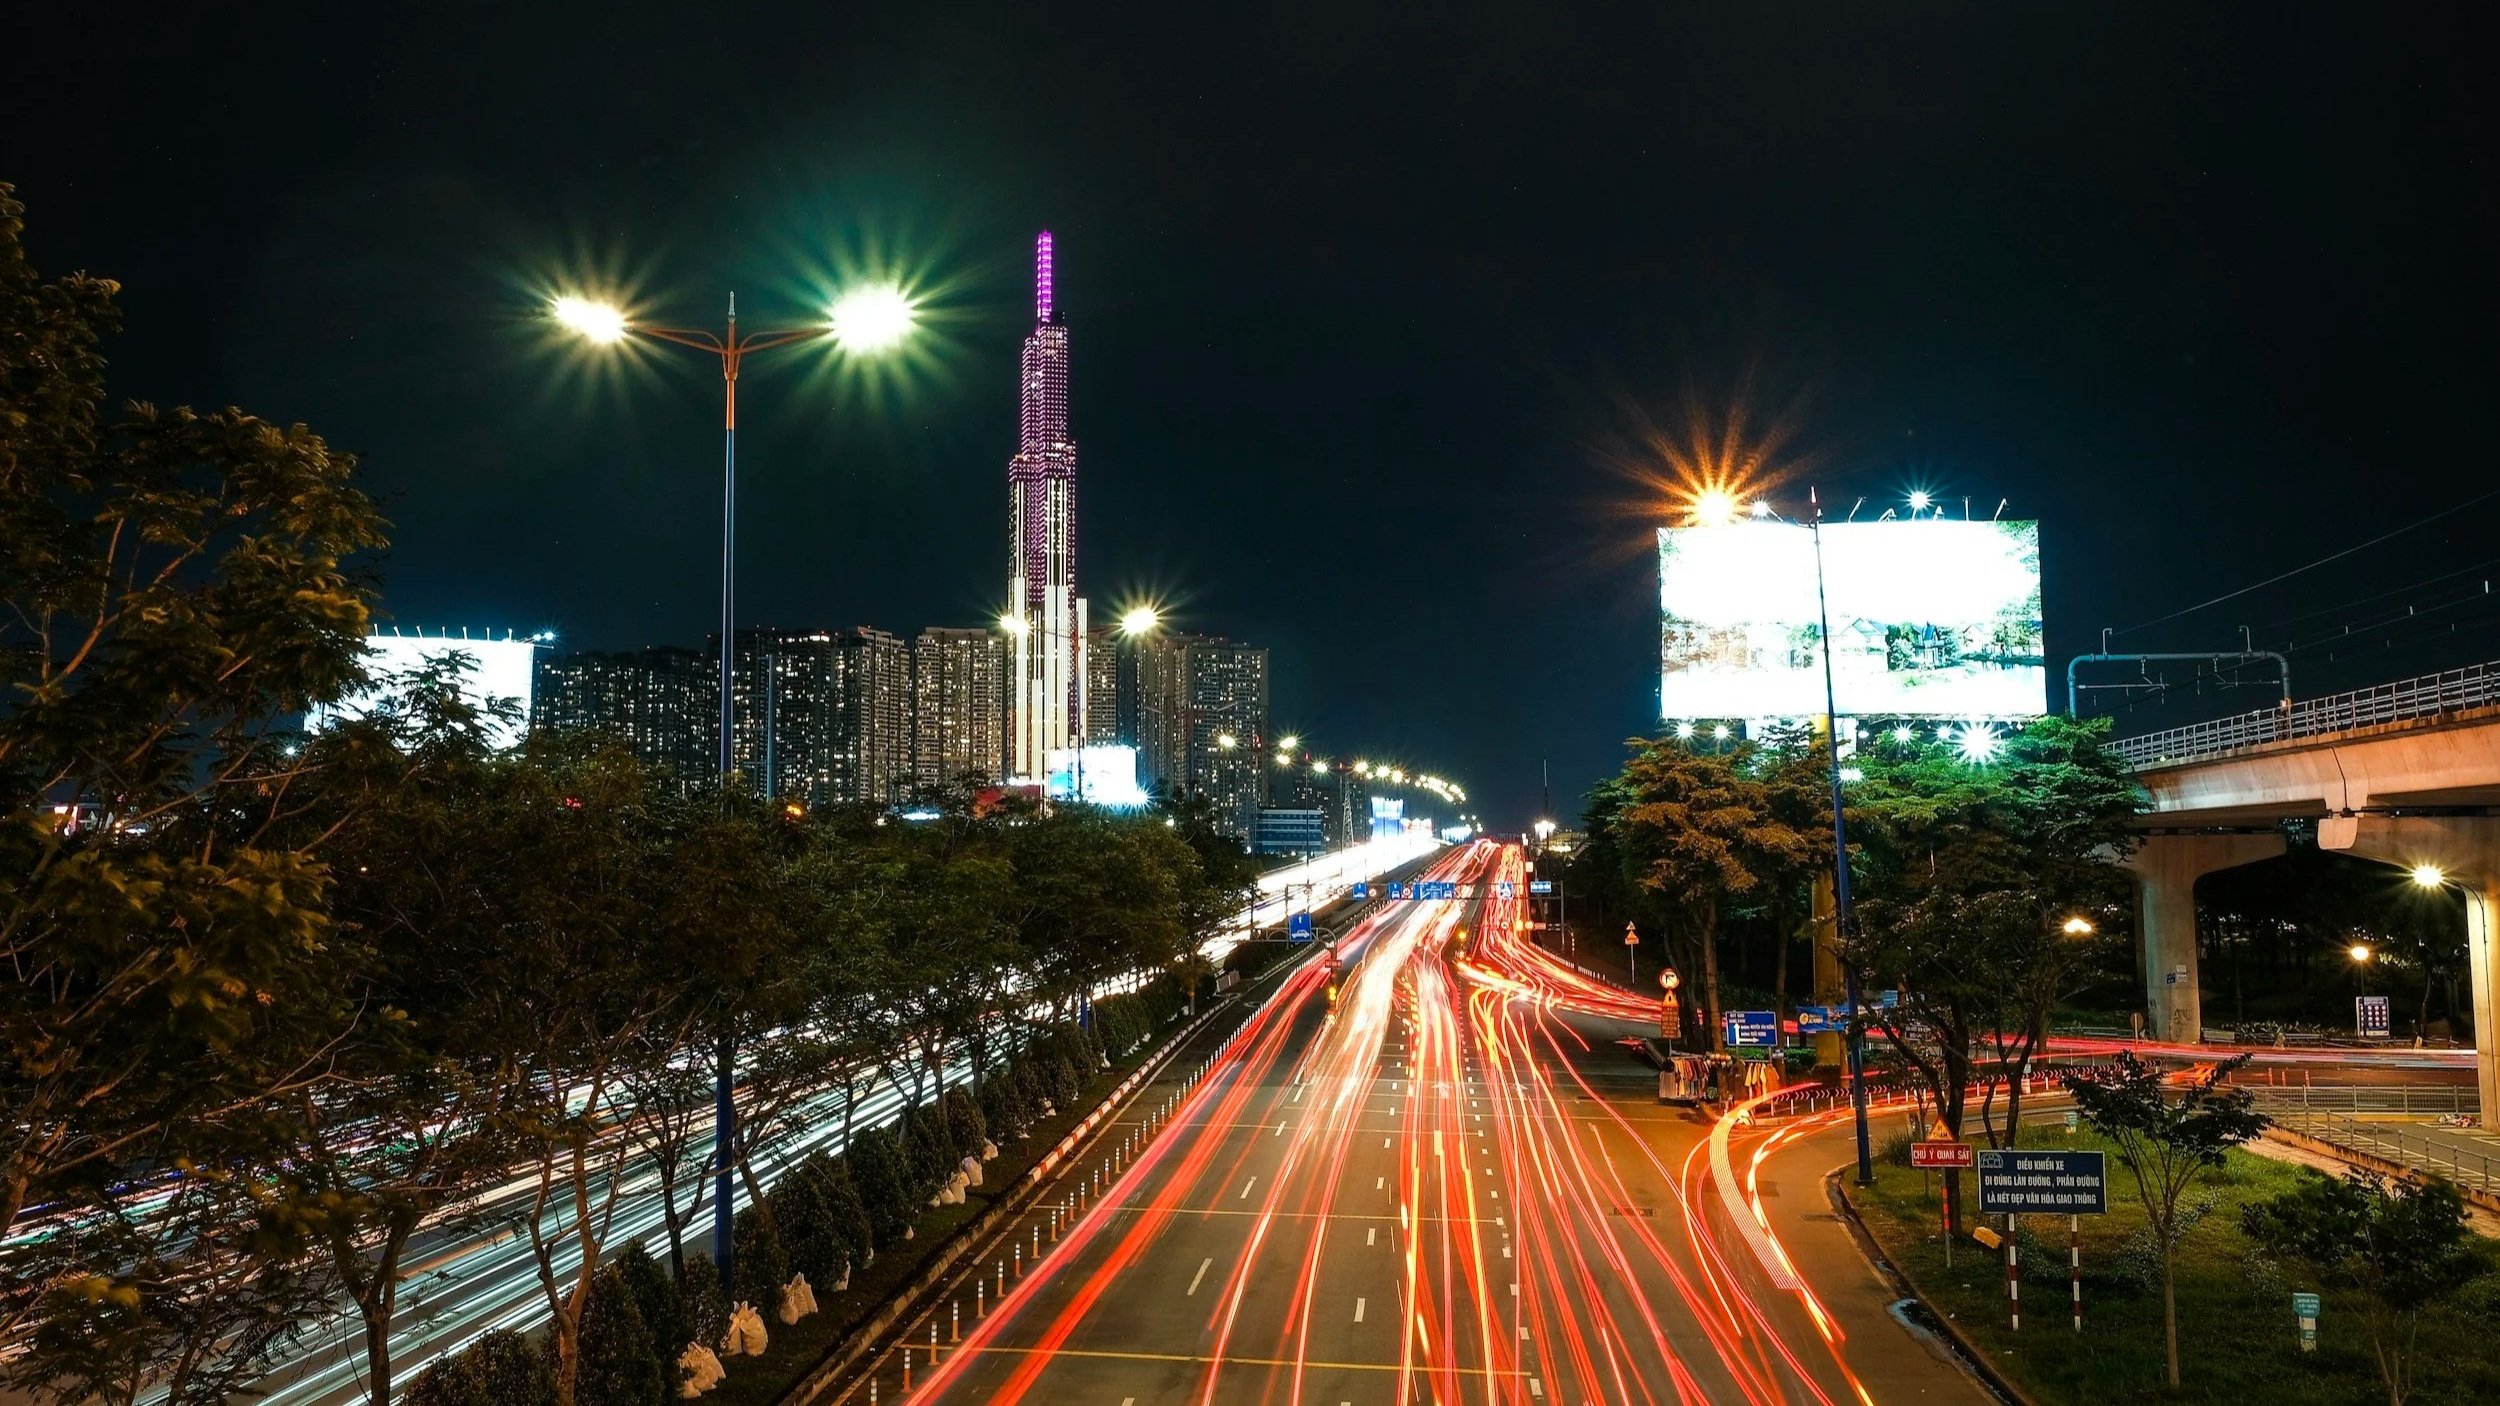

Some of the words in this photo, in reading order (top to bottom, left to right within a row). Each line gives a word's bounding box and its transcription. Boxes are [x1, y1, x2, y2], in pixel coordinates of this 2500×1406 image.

[1913, 1147, 1927, 1160] CHÚ
[1929, 1147, 1935, 1160] Ý
[1936, 1150, 1955, 1160] QUAN
[1957, 1147, 1970, 1160] SÁT
[2055, 1160, 2065, 1171] XE
[1985, 1175, 1993, 1186] ĐI
[1993, 1173, 2012, 1186] ĐÚNG
[1987, 1190, 1996, 1203] LÀ
[1996, 1191, 2010, 1204] NÉT
[2040, 1191, 2055, 1204] HÓA
[2056, 1194, 2073, 1205] GIAO
[2073, 1191, 2097, 1205] THÔNG
